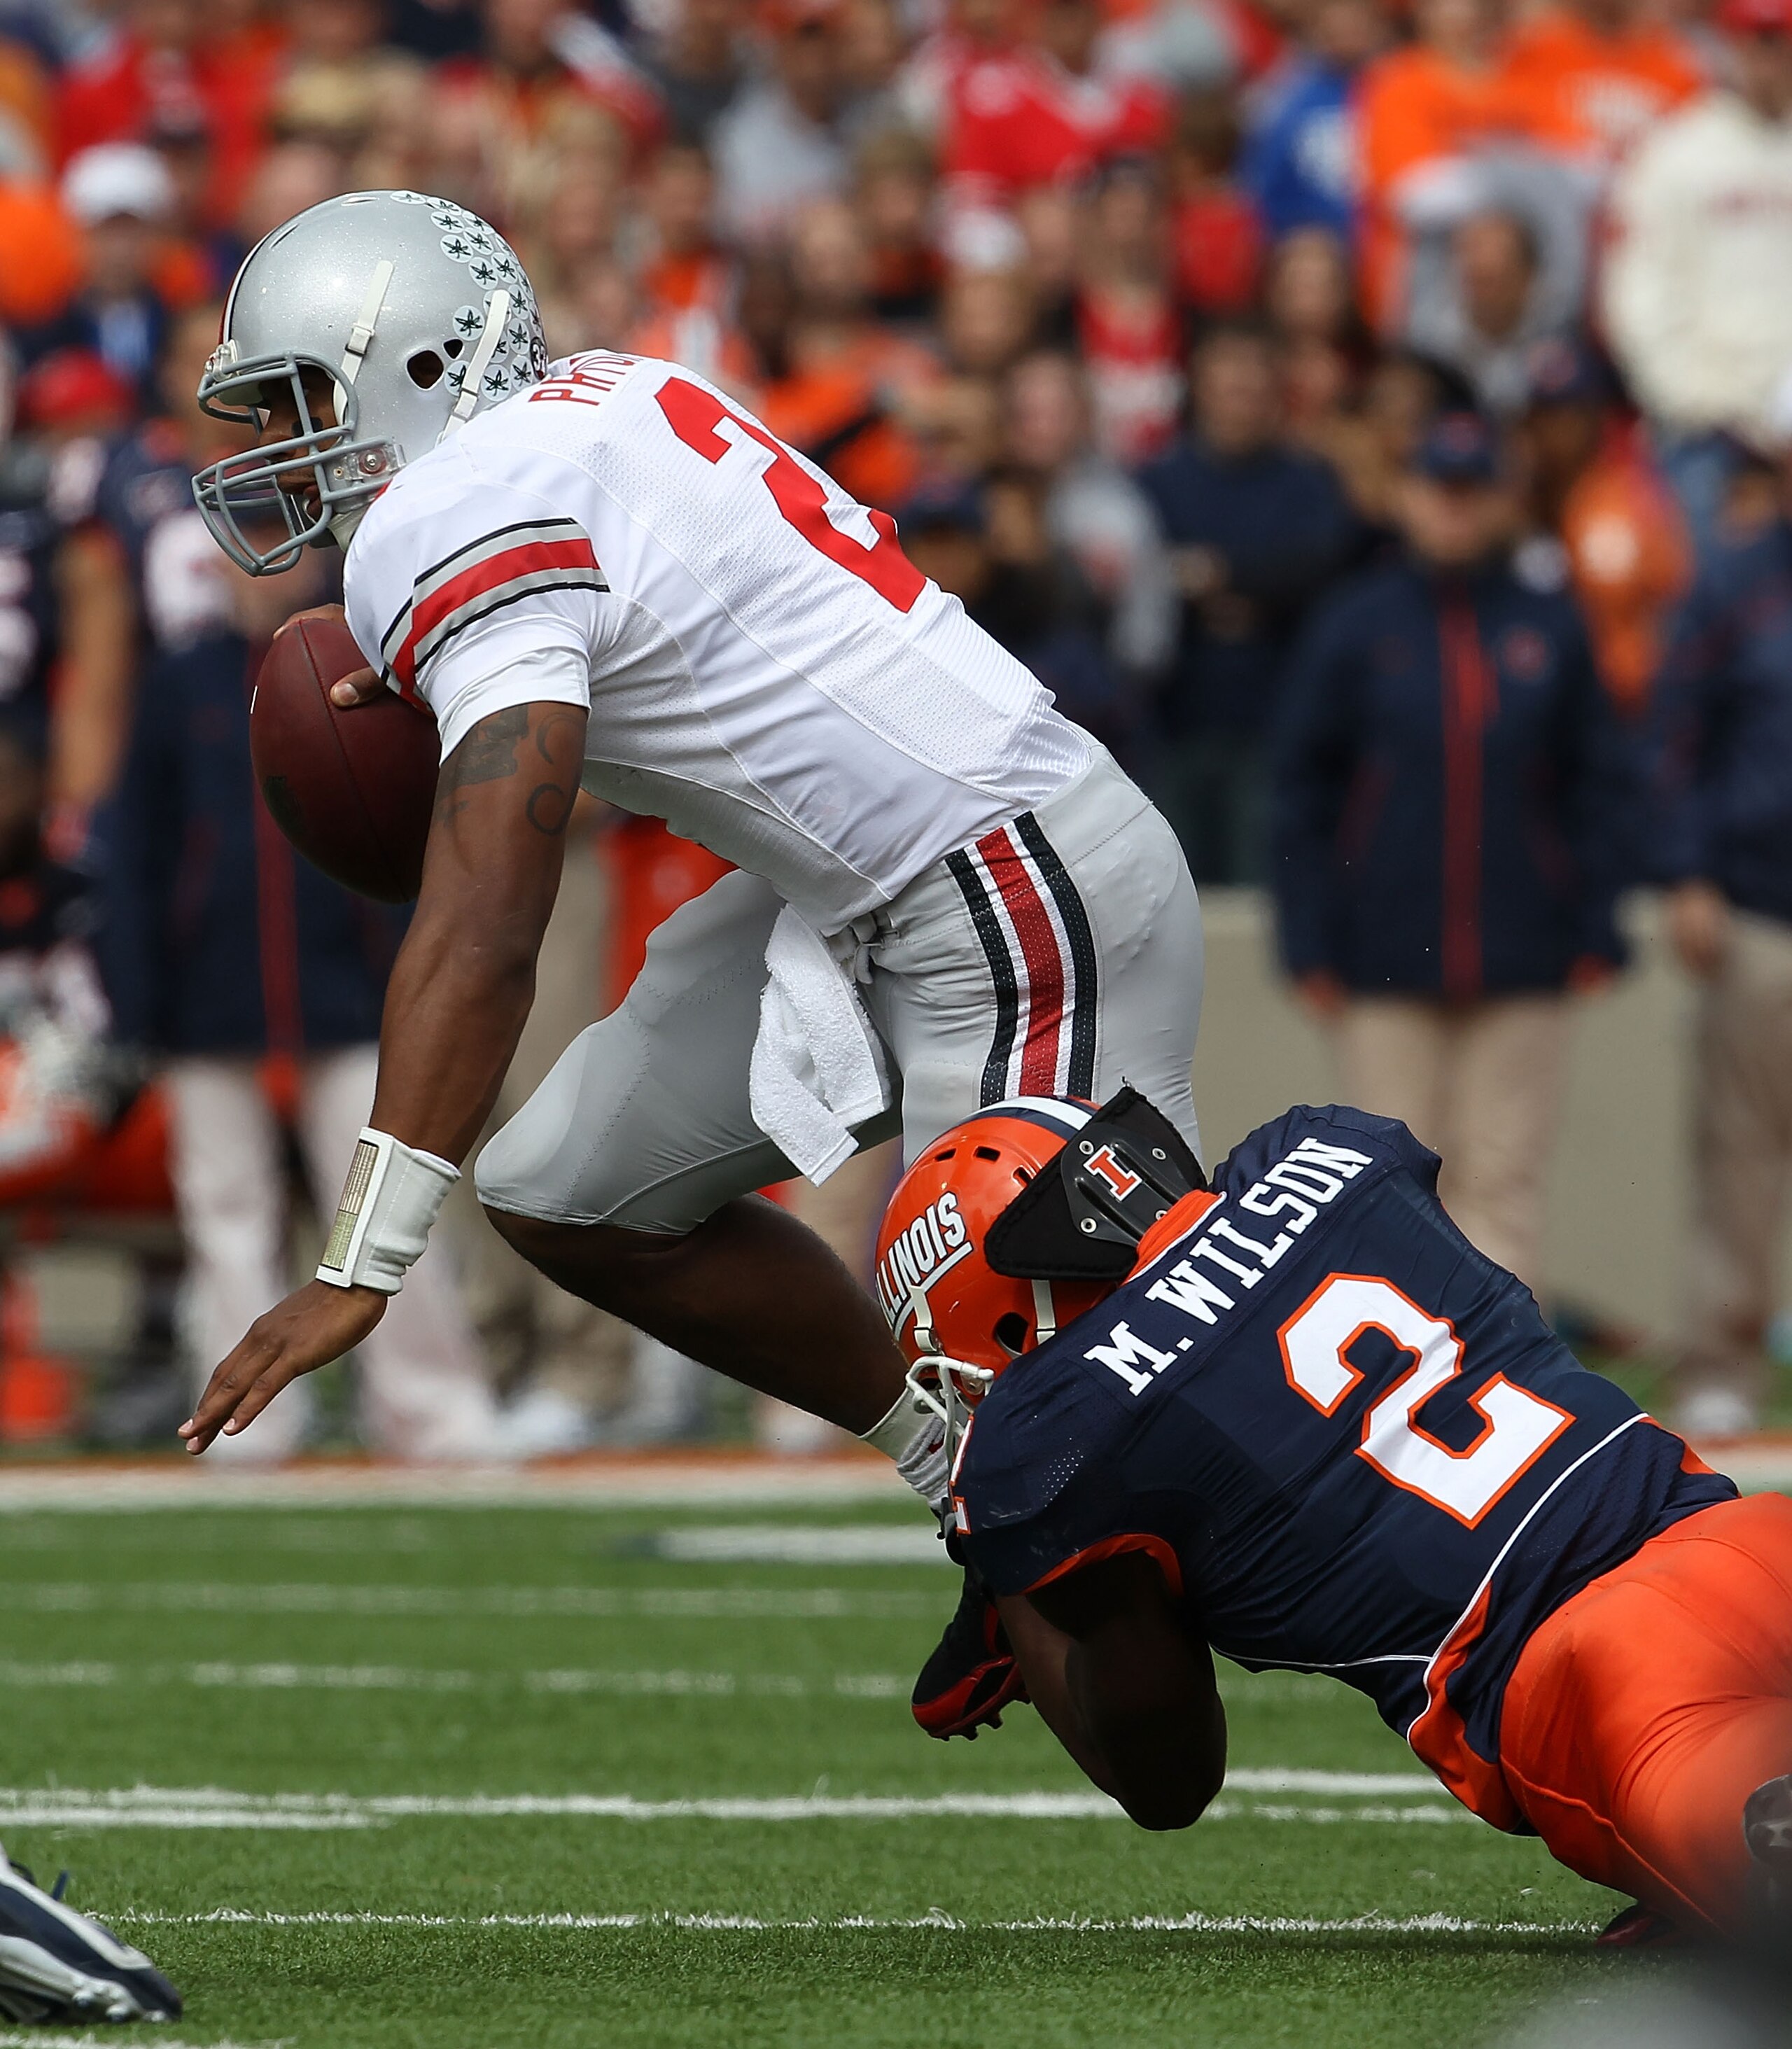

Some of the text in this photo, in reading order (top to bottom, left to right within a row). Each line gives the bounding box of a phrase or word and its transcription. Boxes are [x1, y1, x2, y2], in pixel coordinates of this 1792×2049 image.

[654, 377, 927, 613] 2
[1083, 1144, 1142, 1201] I
[1083, 1137, 1373, 1397] M. WILSON
[1276, 1272, 1577, 1530] 2
